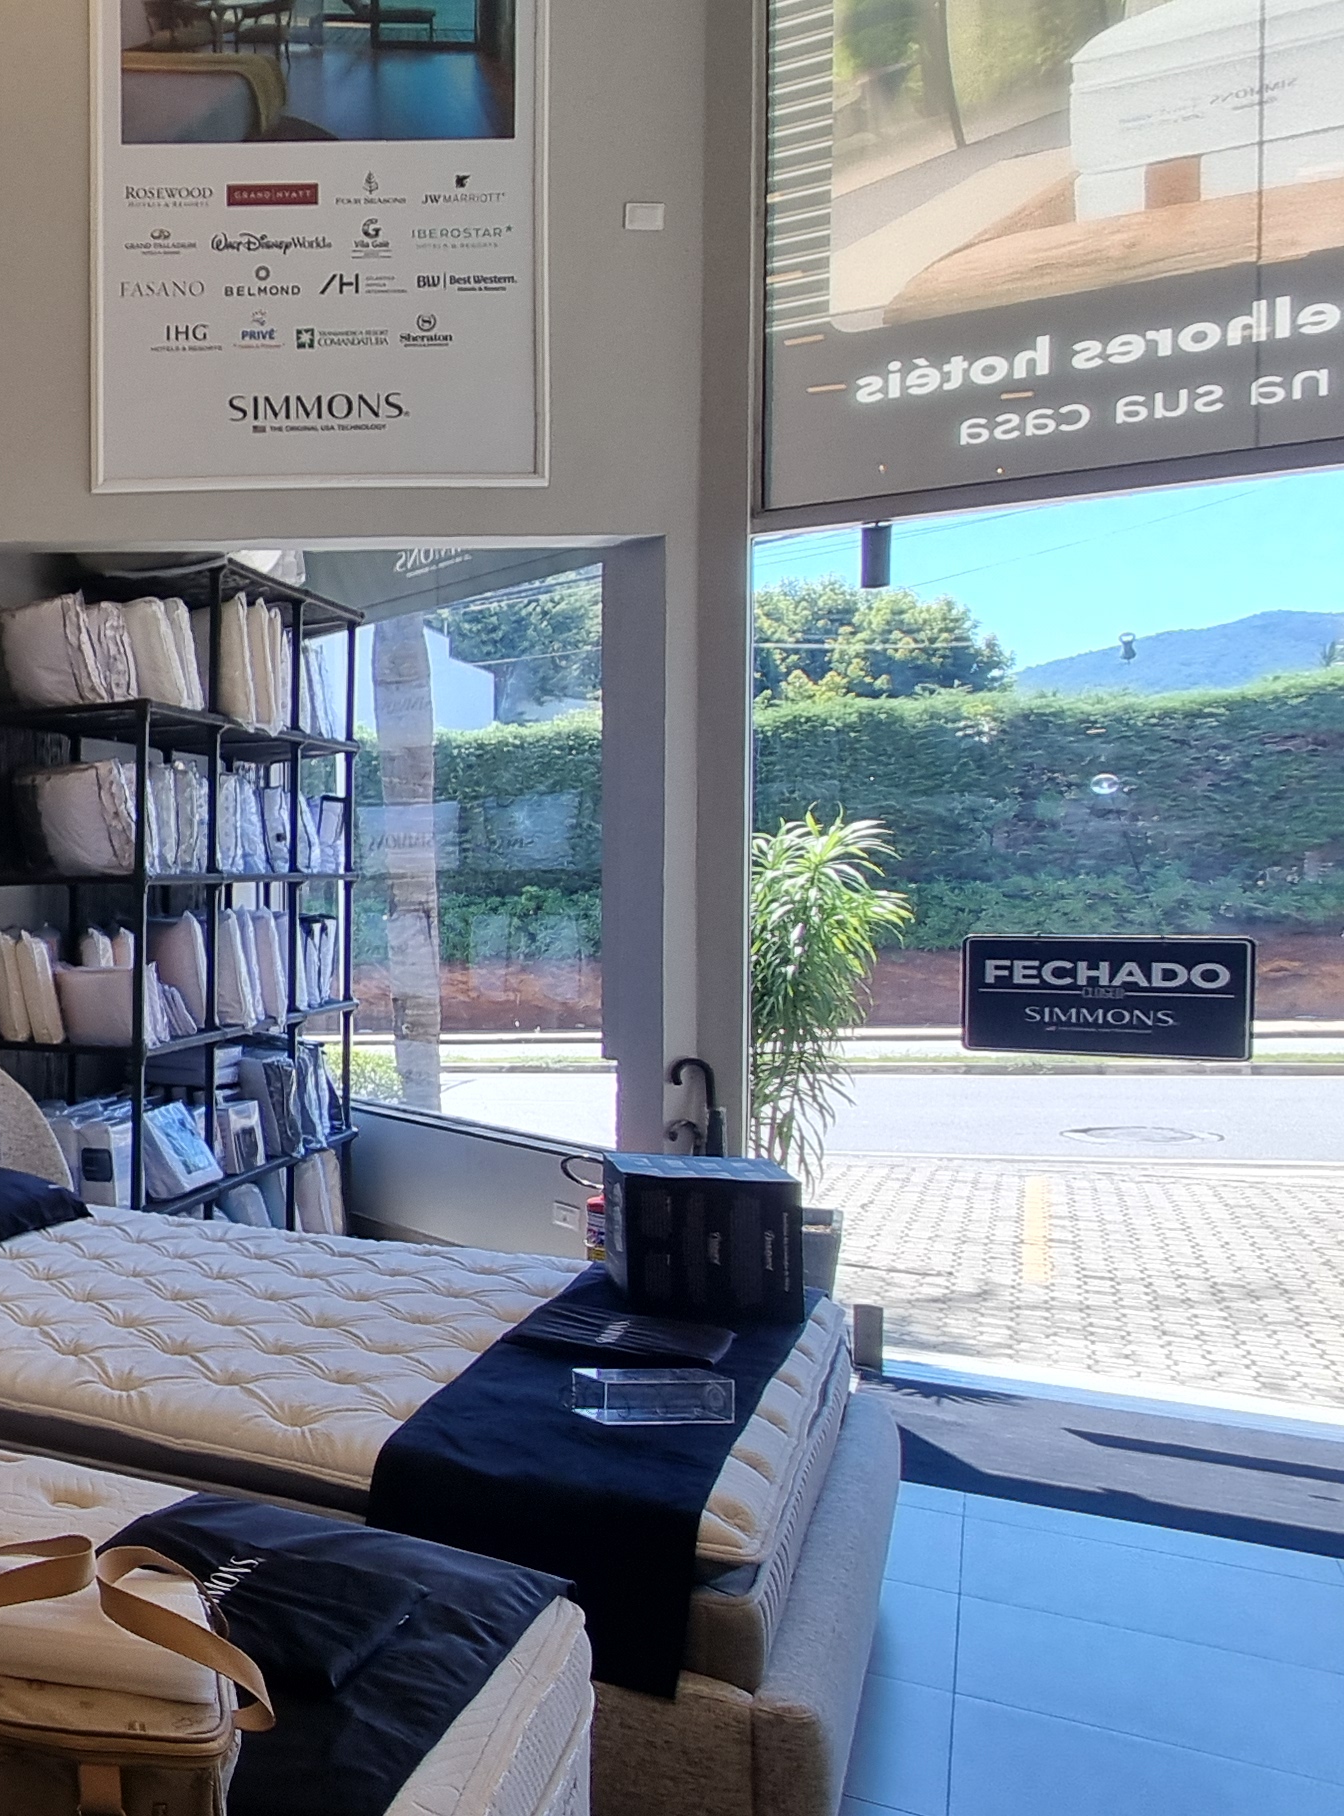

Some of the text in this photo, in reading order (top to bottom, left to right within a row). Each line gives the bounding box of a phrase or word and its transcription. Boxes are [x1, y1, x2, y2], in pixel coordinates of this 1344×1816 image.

[125, 186, 213, 200] ROSEWOOD
[234, 189, 312, 199] GRAND HYATT
[422, 193, 501, 204] JW MARRIOTT
[412, 226, 502, 239] IBEROSTAR
[449, 275, 472, 285] Best
[120, 281, 205, 298] FASANO
[224, 285, 301, 297] BELMOND
[166, 323, 209, 342] IHG
[241, 328, 275, 340] PRIVÉ
[400, 333, 453, 343] Sheraton
[228, 392, 403, 422] SIMMONS
[984, 959, 1231, 989] FECHADO
[1081, 987, 1125, 999] CLOSED
[1025, 1006, 1175, 1027] SIMMONS
